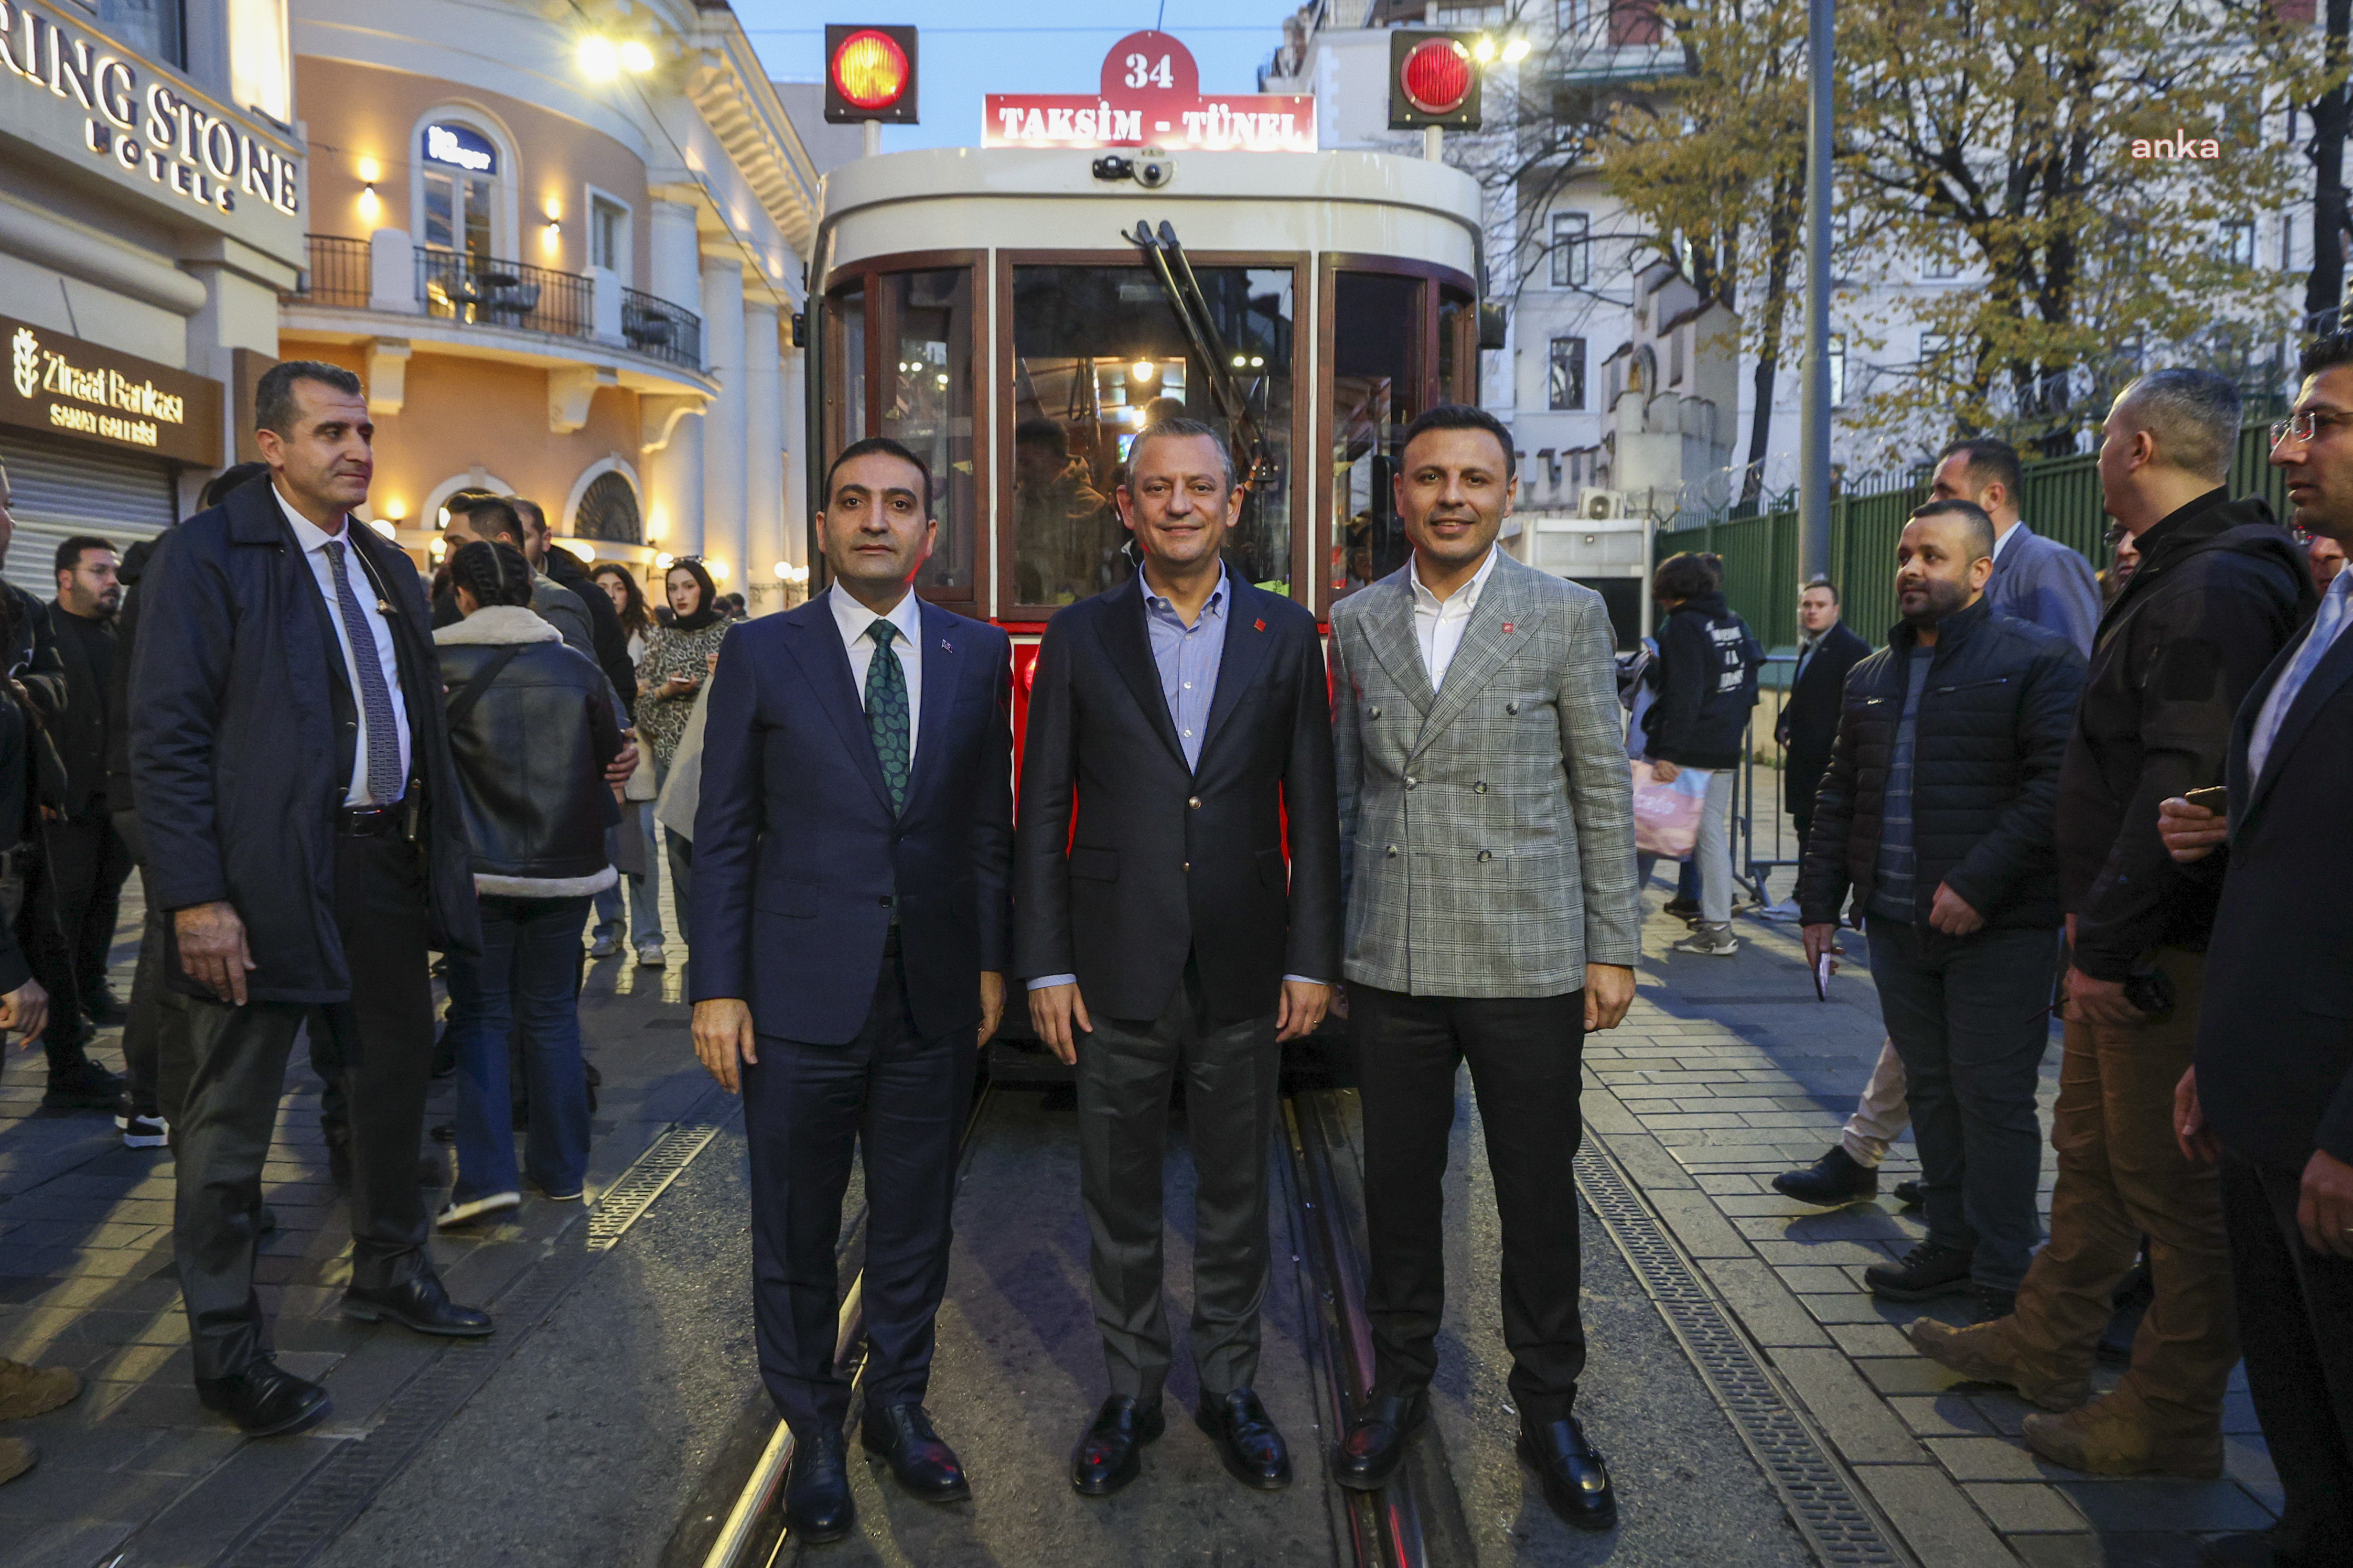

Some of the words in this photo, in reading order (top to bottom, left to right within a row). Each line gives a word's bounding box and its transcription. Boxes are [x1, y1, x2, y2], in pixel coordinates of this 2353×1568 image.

[1124, 53, 1174, 89] 34
[146, 83, 299, 216] STONE
[999, 101, 1142, 141] TAKSİM
[1182, 103, 1302, 144] TÜNEL
[85, 117, 235, 215] HOTELS
[43, 350, 108, 407] Ziraat
[109, 369, 184, 425] Bankası
